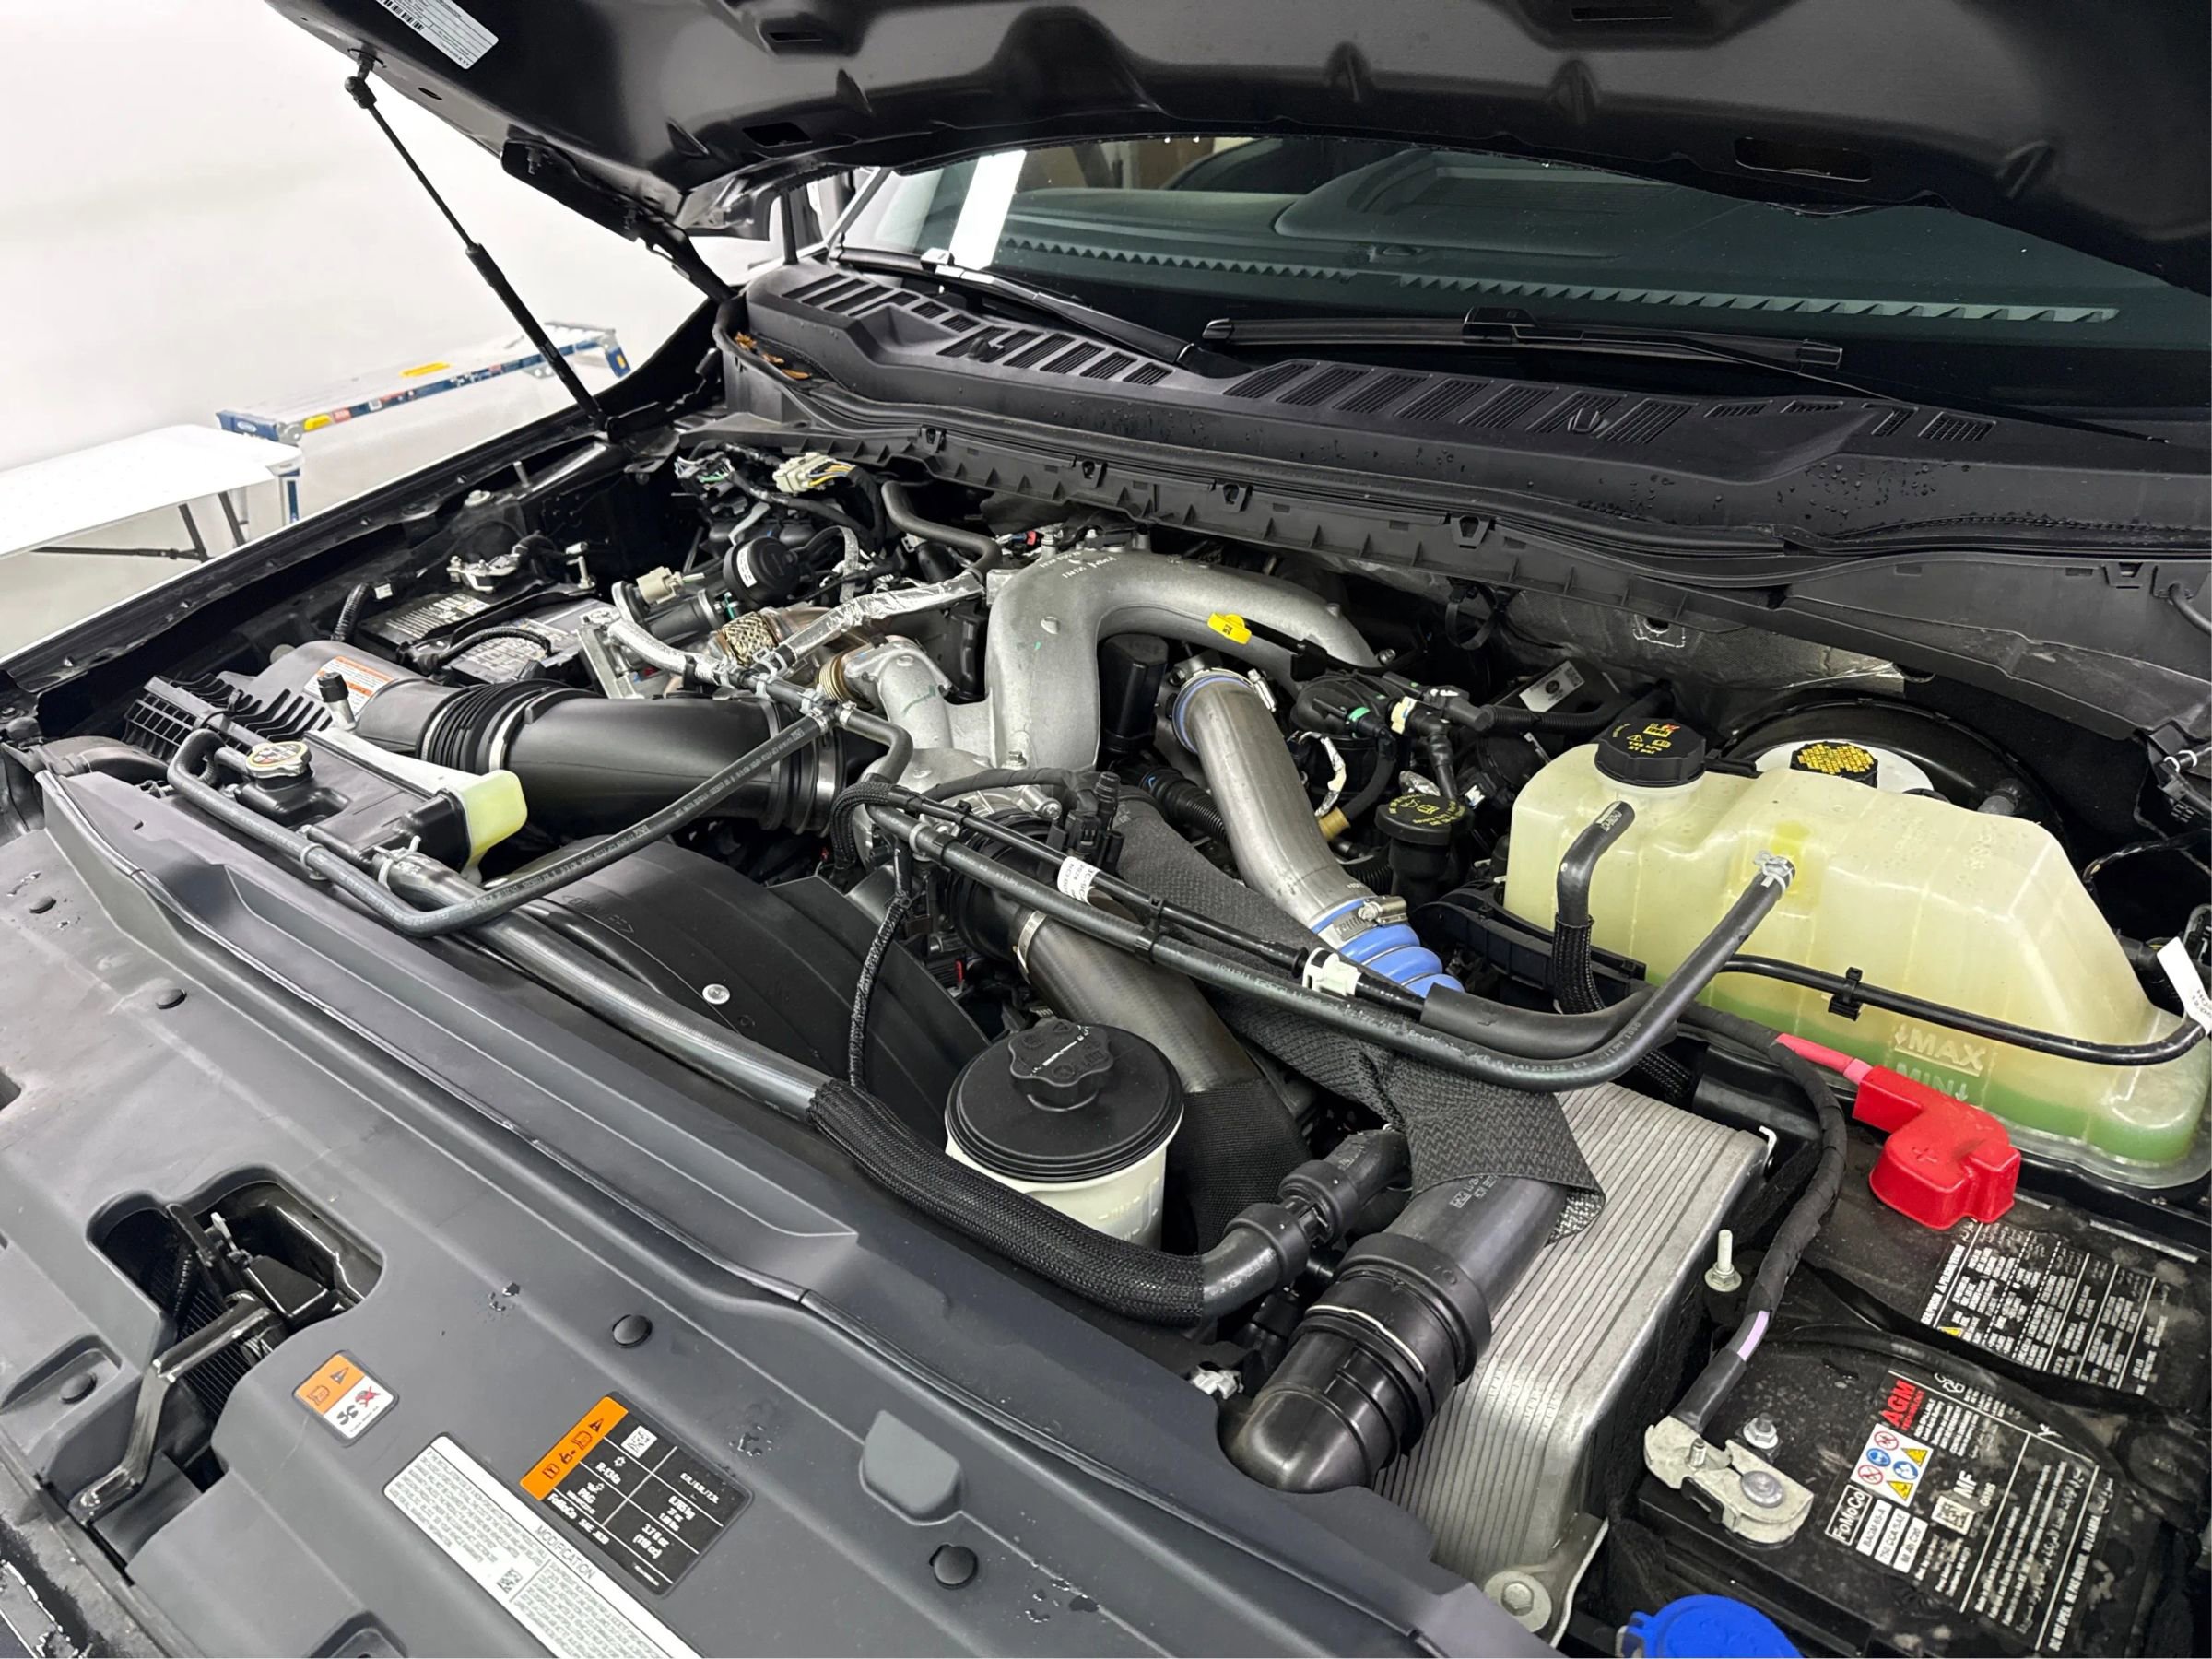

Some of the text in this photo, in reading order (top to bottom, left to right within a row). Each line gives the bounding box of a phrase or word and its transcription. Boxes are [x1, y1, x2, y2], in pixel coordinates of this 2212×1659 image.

[1908, 1027, 1986, 1071] MAX
[1895, 1062, 1954, 1096] MIN
[1880, 1379, 1917, 1427] AGM
[595, 1461, 622, 1485] R-134a
[1953, 1469, 1980, 1499] MF
[546, 1491, 579, 1521] FoMoCo
[576, 1487, 596, 1505] PAG
[1831, 1488, 1866, 1540] FoMoCo
[534, 1524, 596, 1581] MODIFICATION
